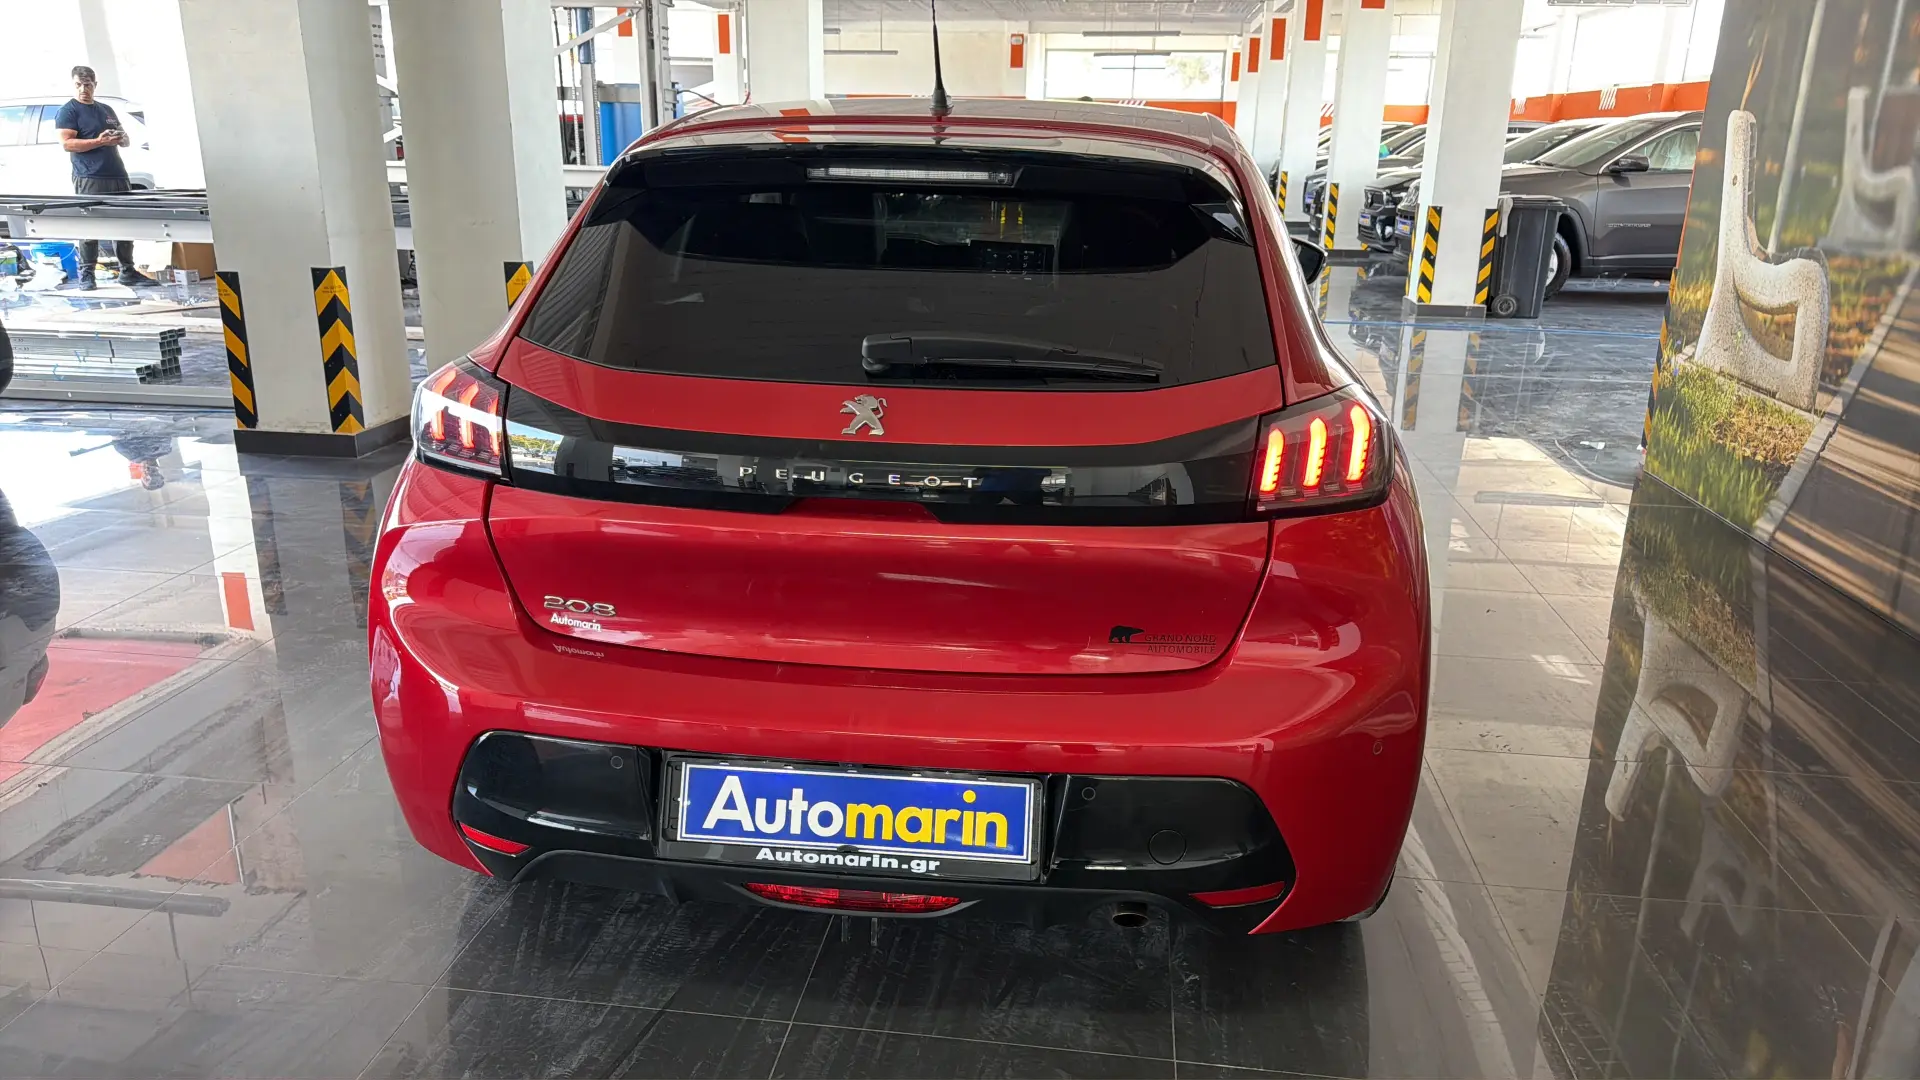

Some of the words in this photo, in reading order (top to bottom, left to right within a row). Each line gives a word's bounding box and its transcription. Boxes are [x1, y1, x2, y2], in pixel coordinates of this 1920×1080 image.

[739, 466, 979, 489] PEUGEOT
[543, 594, 616, 617] 208
[550, 612, 602, 632] Automarin
[1144, 633, 1183, 643] GRAND
[1185, 634, 1217, 644] NORD
[1148, 645, 1216, 655] AUTOMOBILE
[701, 775, 1009, 849] Automarin
[755, 846, 941, 873] Automarin.gr
